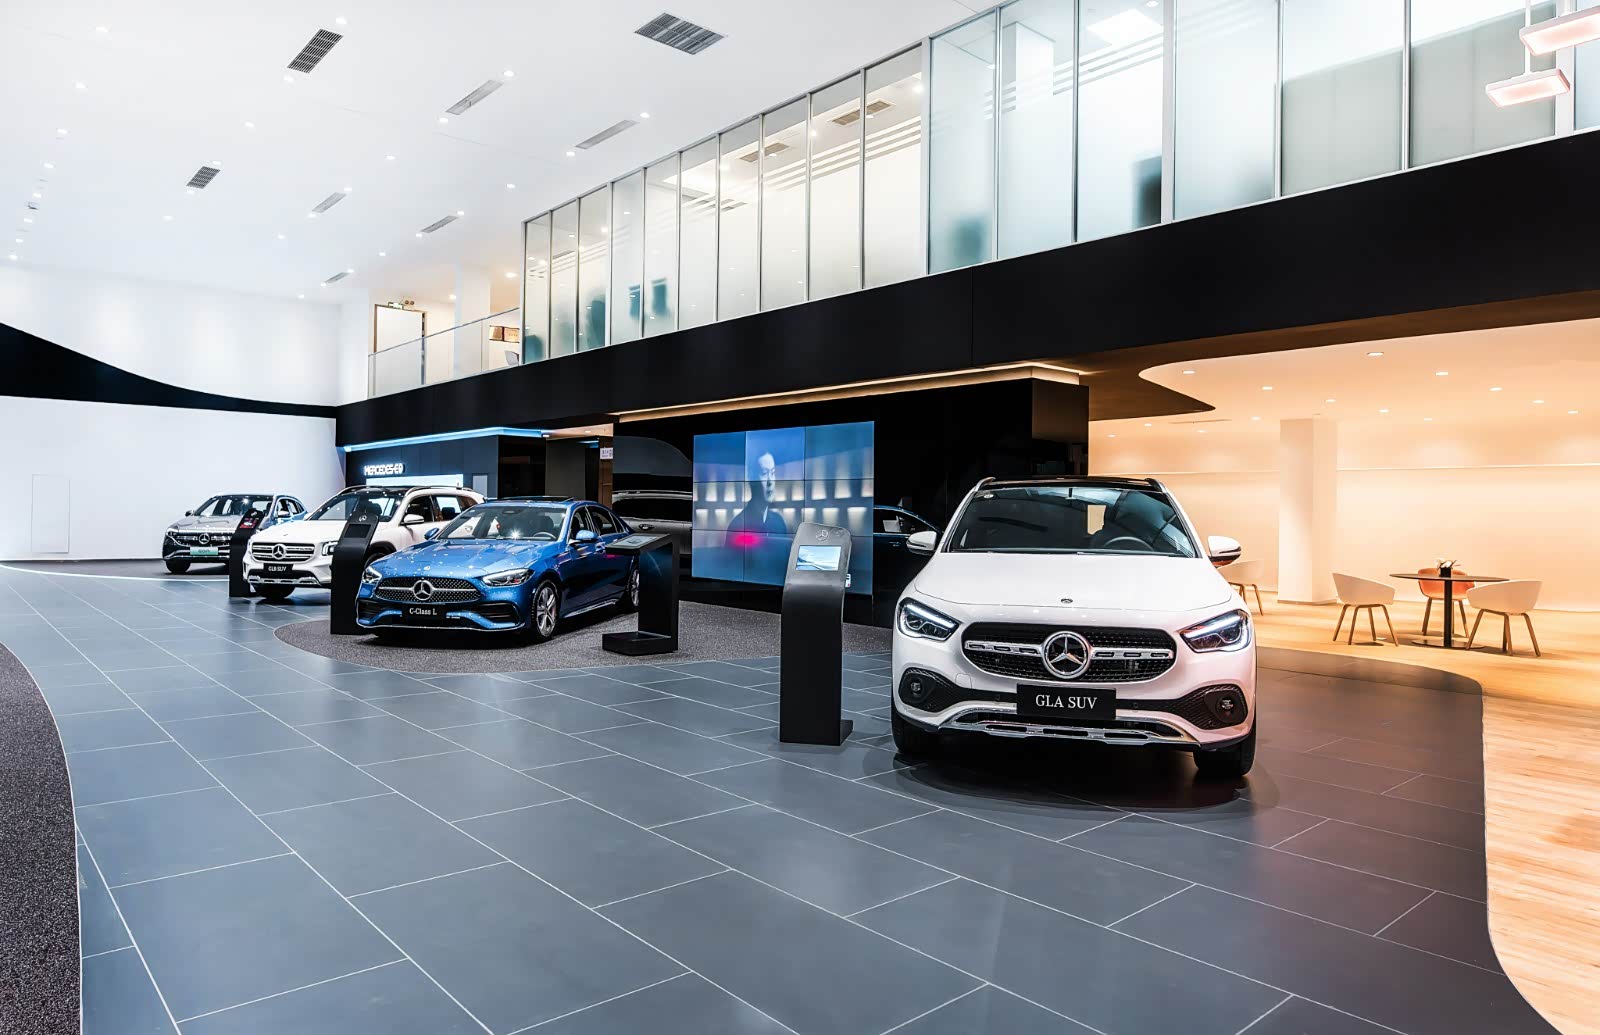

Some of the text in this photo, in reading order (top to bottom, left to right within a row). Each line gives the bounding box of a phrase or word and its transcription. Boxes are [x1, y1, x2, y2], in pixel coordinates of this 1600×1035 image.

[410, 608, 438, 616] C-Class L
[1035, 694, 1098, 709] GLA SUV
